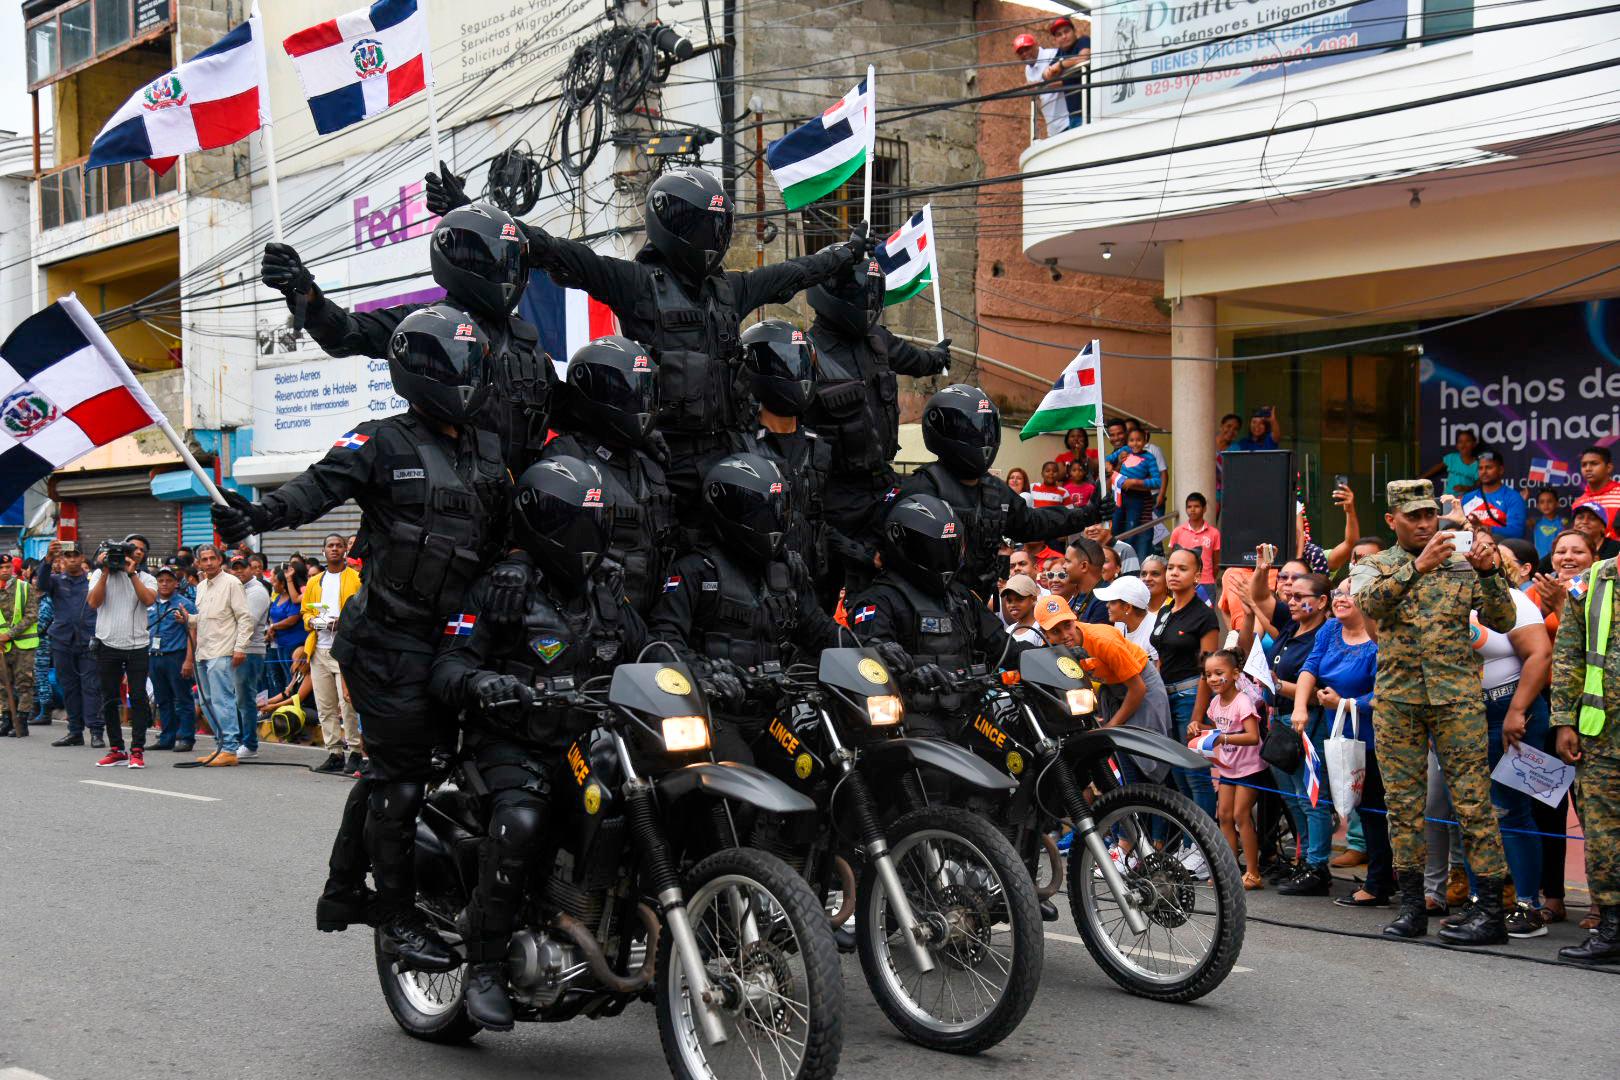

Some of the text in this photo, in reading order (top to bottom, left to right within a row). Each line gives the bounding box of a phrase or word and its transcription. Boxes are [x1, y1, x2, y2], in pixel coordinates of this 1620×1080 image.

[460, 12, 505, 37] Seguros
[510, 4, 524, 18] de
[461, 2, 585, 52] Servicios Migratorios
[1161, 0, 1336, 48] Defensores Litigantes
[462, 42, 511, 69] Solicitud
[533, 26, 565, 42] Visas
[520, 33, 597, 65] Documentos
[1151, 51, 1199, 75] BIENES
[276, 388, 319, 402] Reservaciones
[332, 382, 358, 395] Hoteles
[1440, 367, 1620, 410] hechos de
[276, 417, 311, 430] Excursiones
[768, 717, 800, 756] LINCE
[974, 713, 1008, 749] LINCE
[567, 741, 590, 787] LINCE
